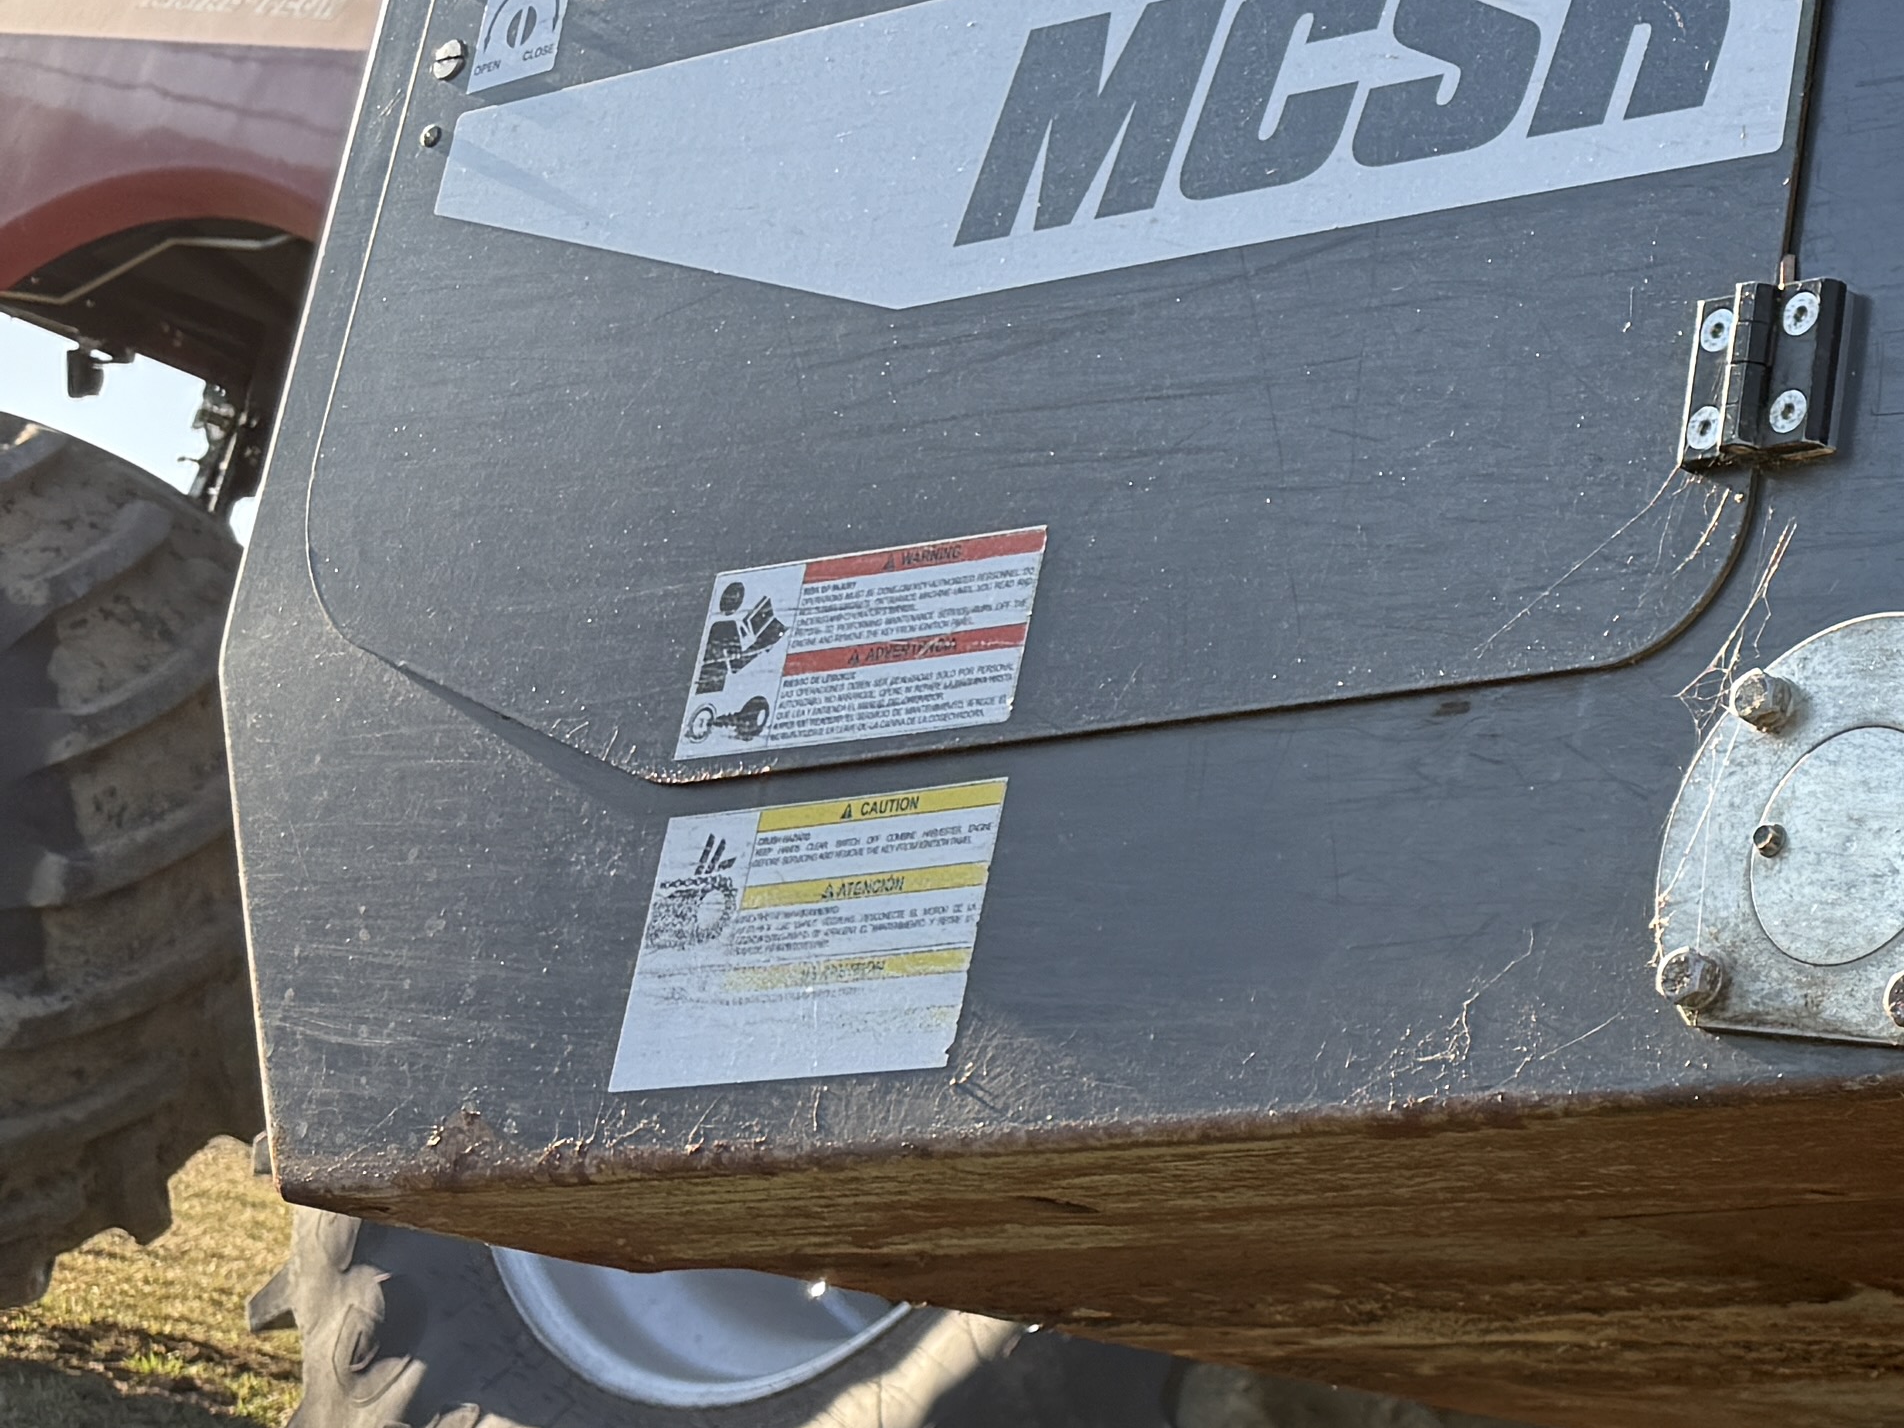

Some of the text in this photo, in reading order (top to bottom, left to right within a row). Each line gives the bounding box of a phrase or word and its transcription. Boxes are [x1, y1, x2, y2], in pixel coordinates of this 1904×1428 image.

[522, 43, 555, 62] CLOSE
[473, 59, 501, 76] OPEN
[902, 547, 962, 564] WARNING
[860, 795, 920, 816] CAUTION
